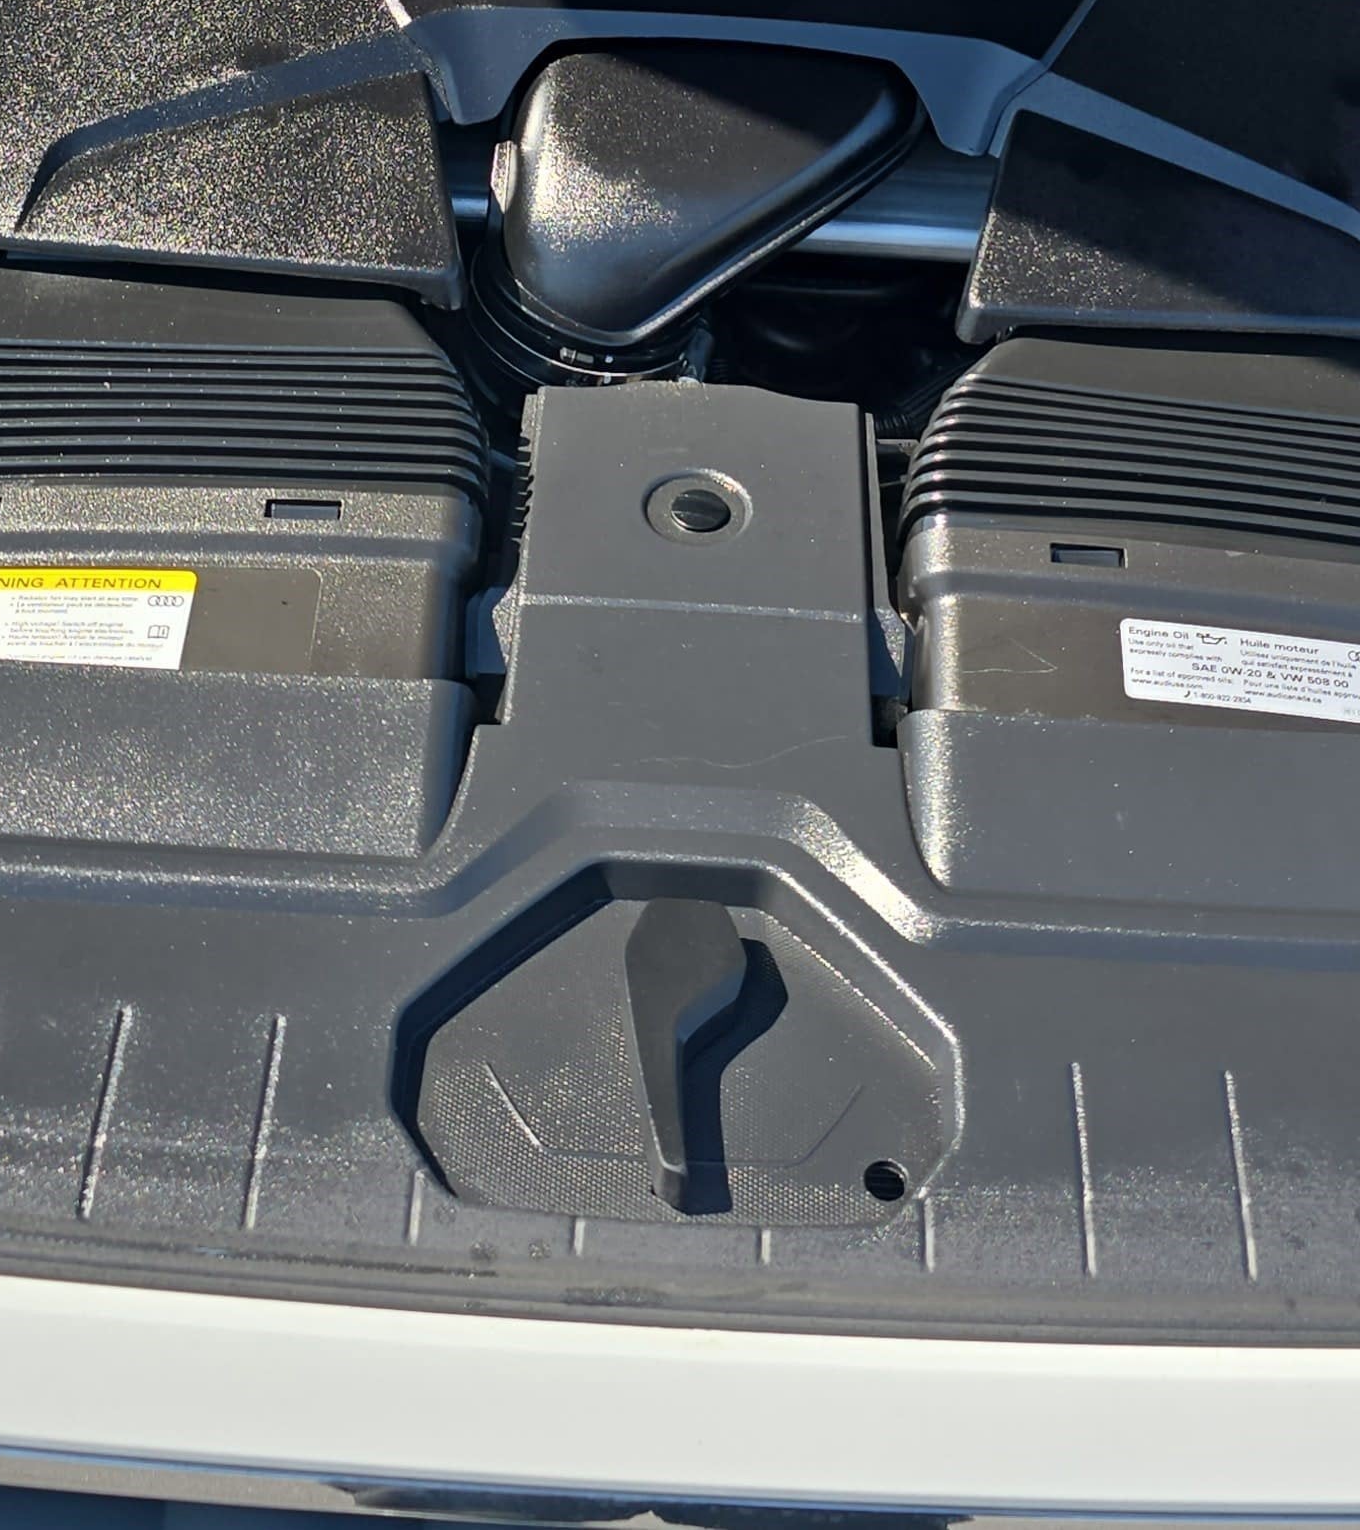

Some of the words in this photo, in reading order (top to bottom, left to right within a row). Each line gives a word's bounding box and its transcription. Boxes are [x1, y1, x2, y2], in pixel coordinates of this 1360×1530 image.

[56, 578, 162, 589] ATTENTION
[1128, 626, 1169, 638] Engine
[1173, 631, 1189, 639] Oil
[1240, 638, 1270, 649] Huile
[1274, 643, 1319, 655] moteur
[1192, 662, 1217, 673] SAE
[1221, 665, 1262, 678] 0W-20
[1266, 670, 1276, 679] &
[1280, 672, 1303, 682] VW
[1307, 676, 1330, 686] 508
[1333, 679, 1349, 688] 00
